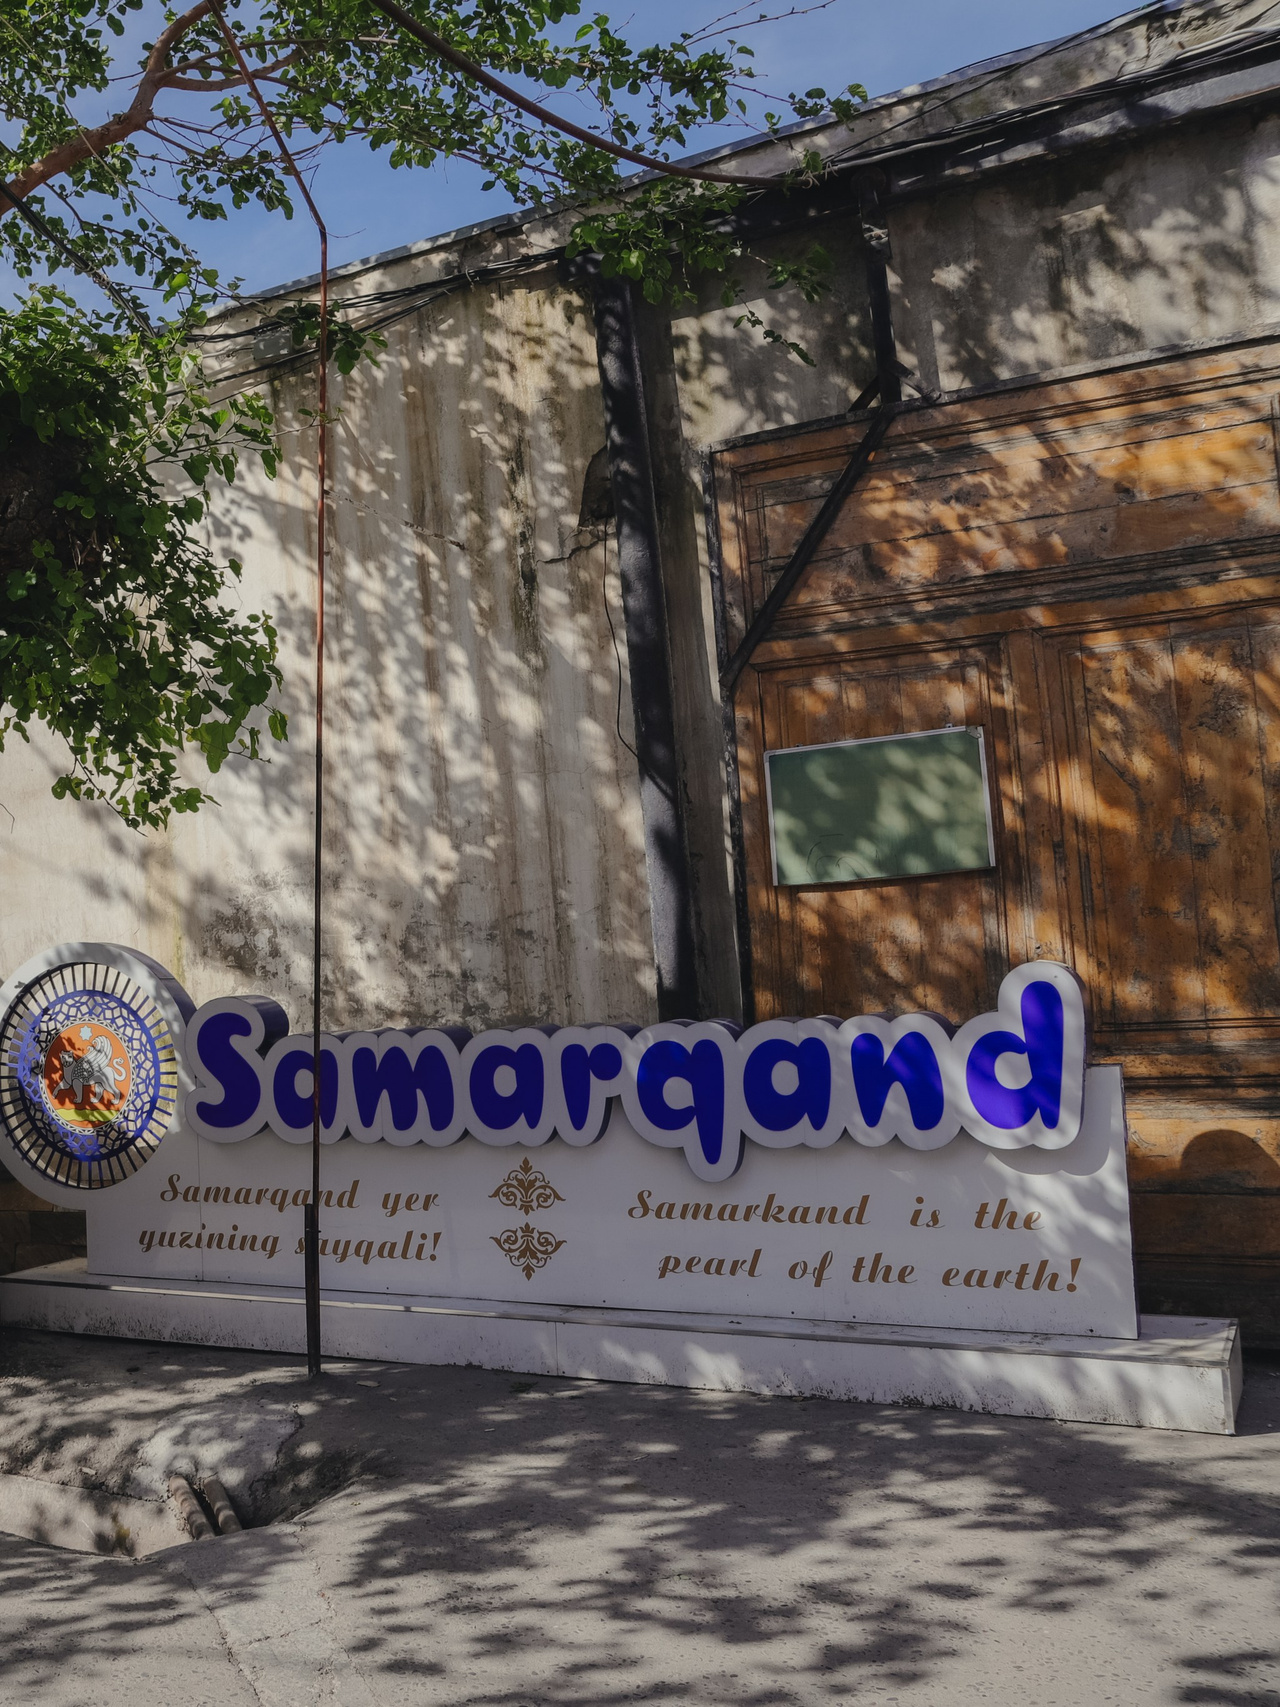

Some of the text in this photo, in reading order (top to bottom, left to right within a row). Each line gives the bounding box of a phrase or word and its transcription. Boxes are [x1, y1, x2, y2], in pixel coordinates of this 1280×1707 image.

[196, 980, 1065, 1166] Samarqand
[160, 1173, 440, 1218] Samarqand yer
[627, 1189, 1045, 1231] Samarkand is the
[138, 1223, 282, 1259] yuzining
[658, 1248, 1083, 1293] pearl of the earth!
